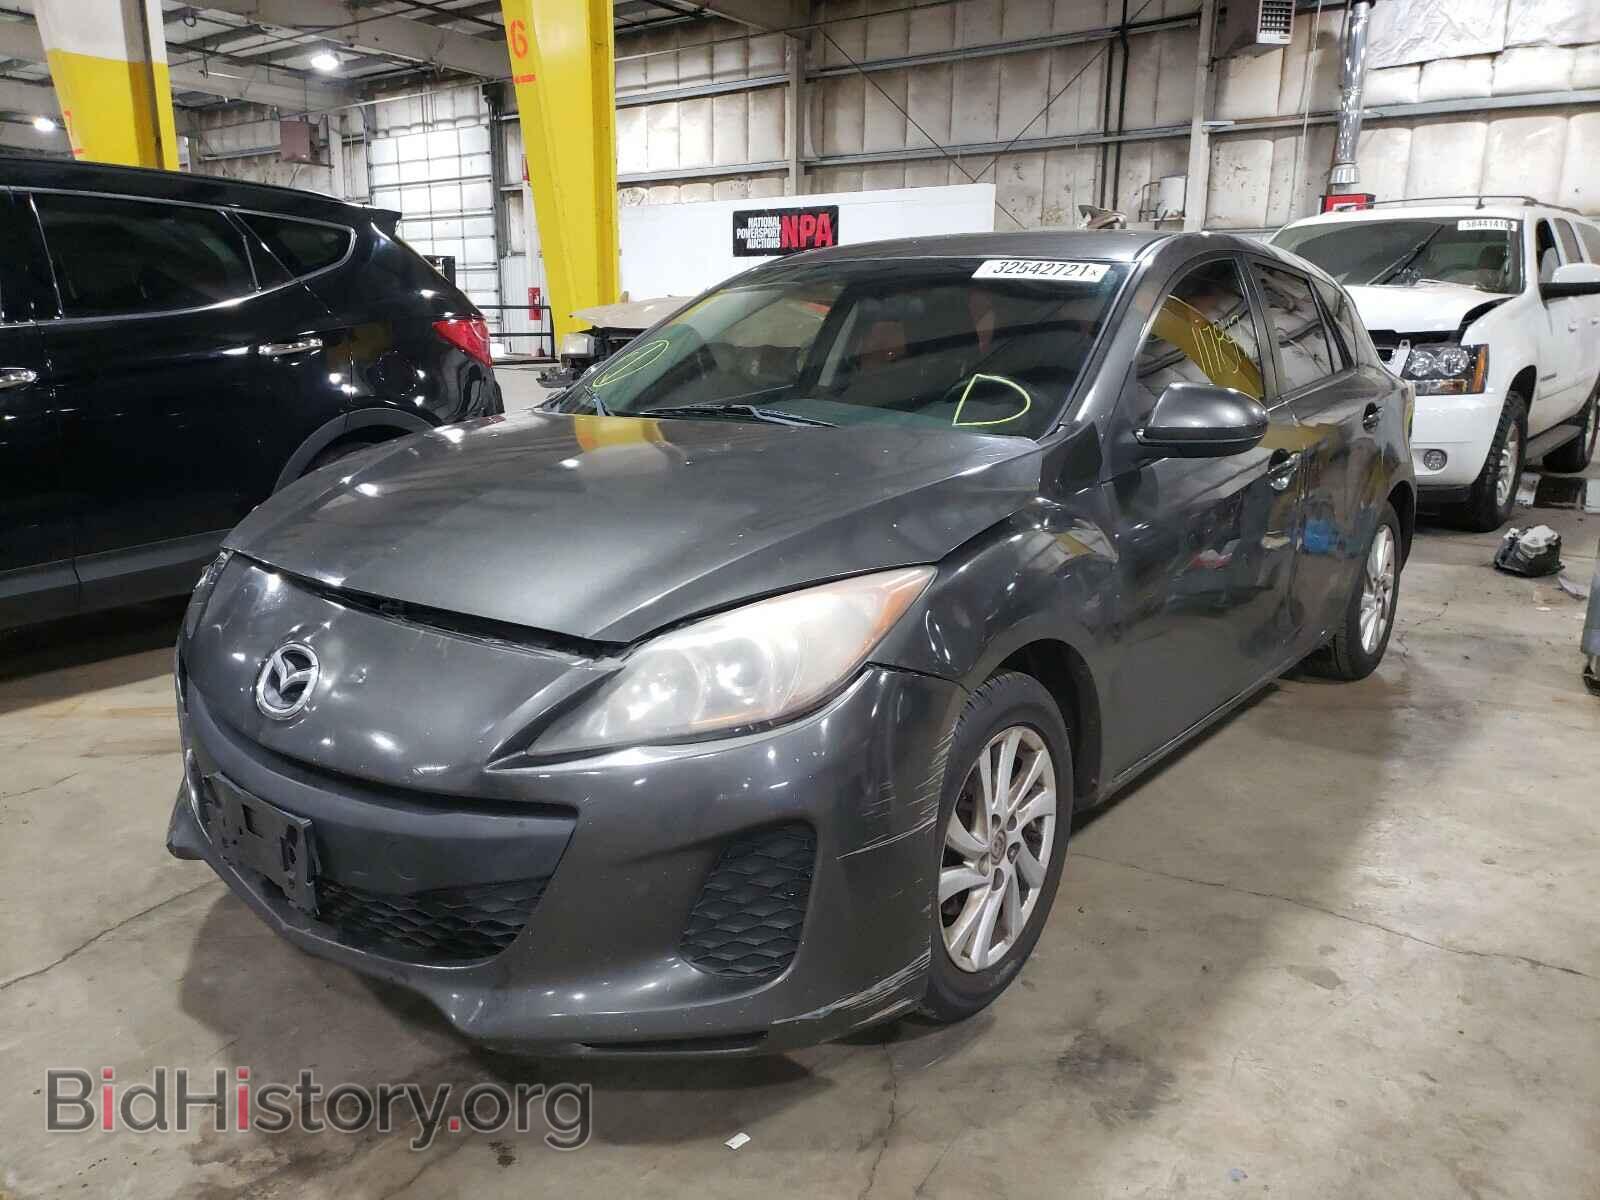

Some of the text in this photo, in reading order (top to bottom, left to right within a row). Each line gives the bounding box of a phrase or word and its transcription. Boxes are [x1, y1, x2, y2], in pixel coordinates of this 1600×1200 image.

[510, 19, 529, 60] 6
[748, 216, 780, 229] NATIONAL
[736, 226, 781, 240] POWERSPORT
[781, 212, 833, 249] NPA
[746, 237, 780, 250] AUCTIONS
[993, 261, 1089, 277] 32542721
